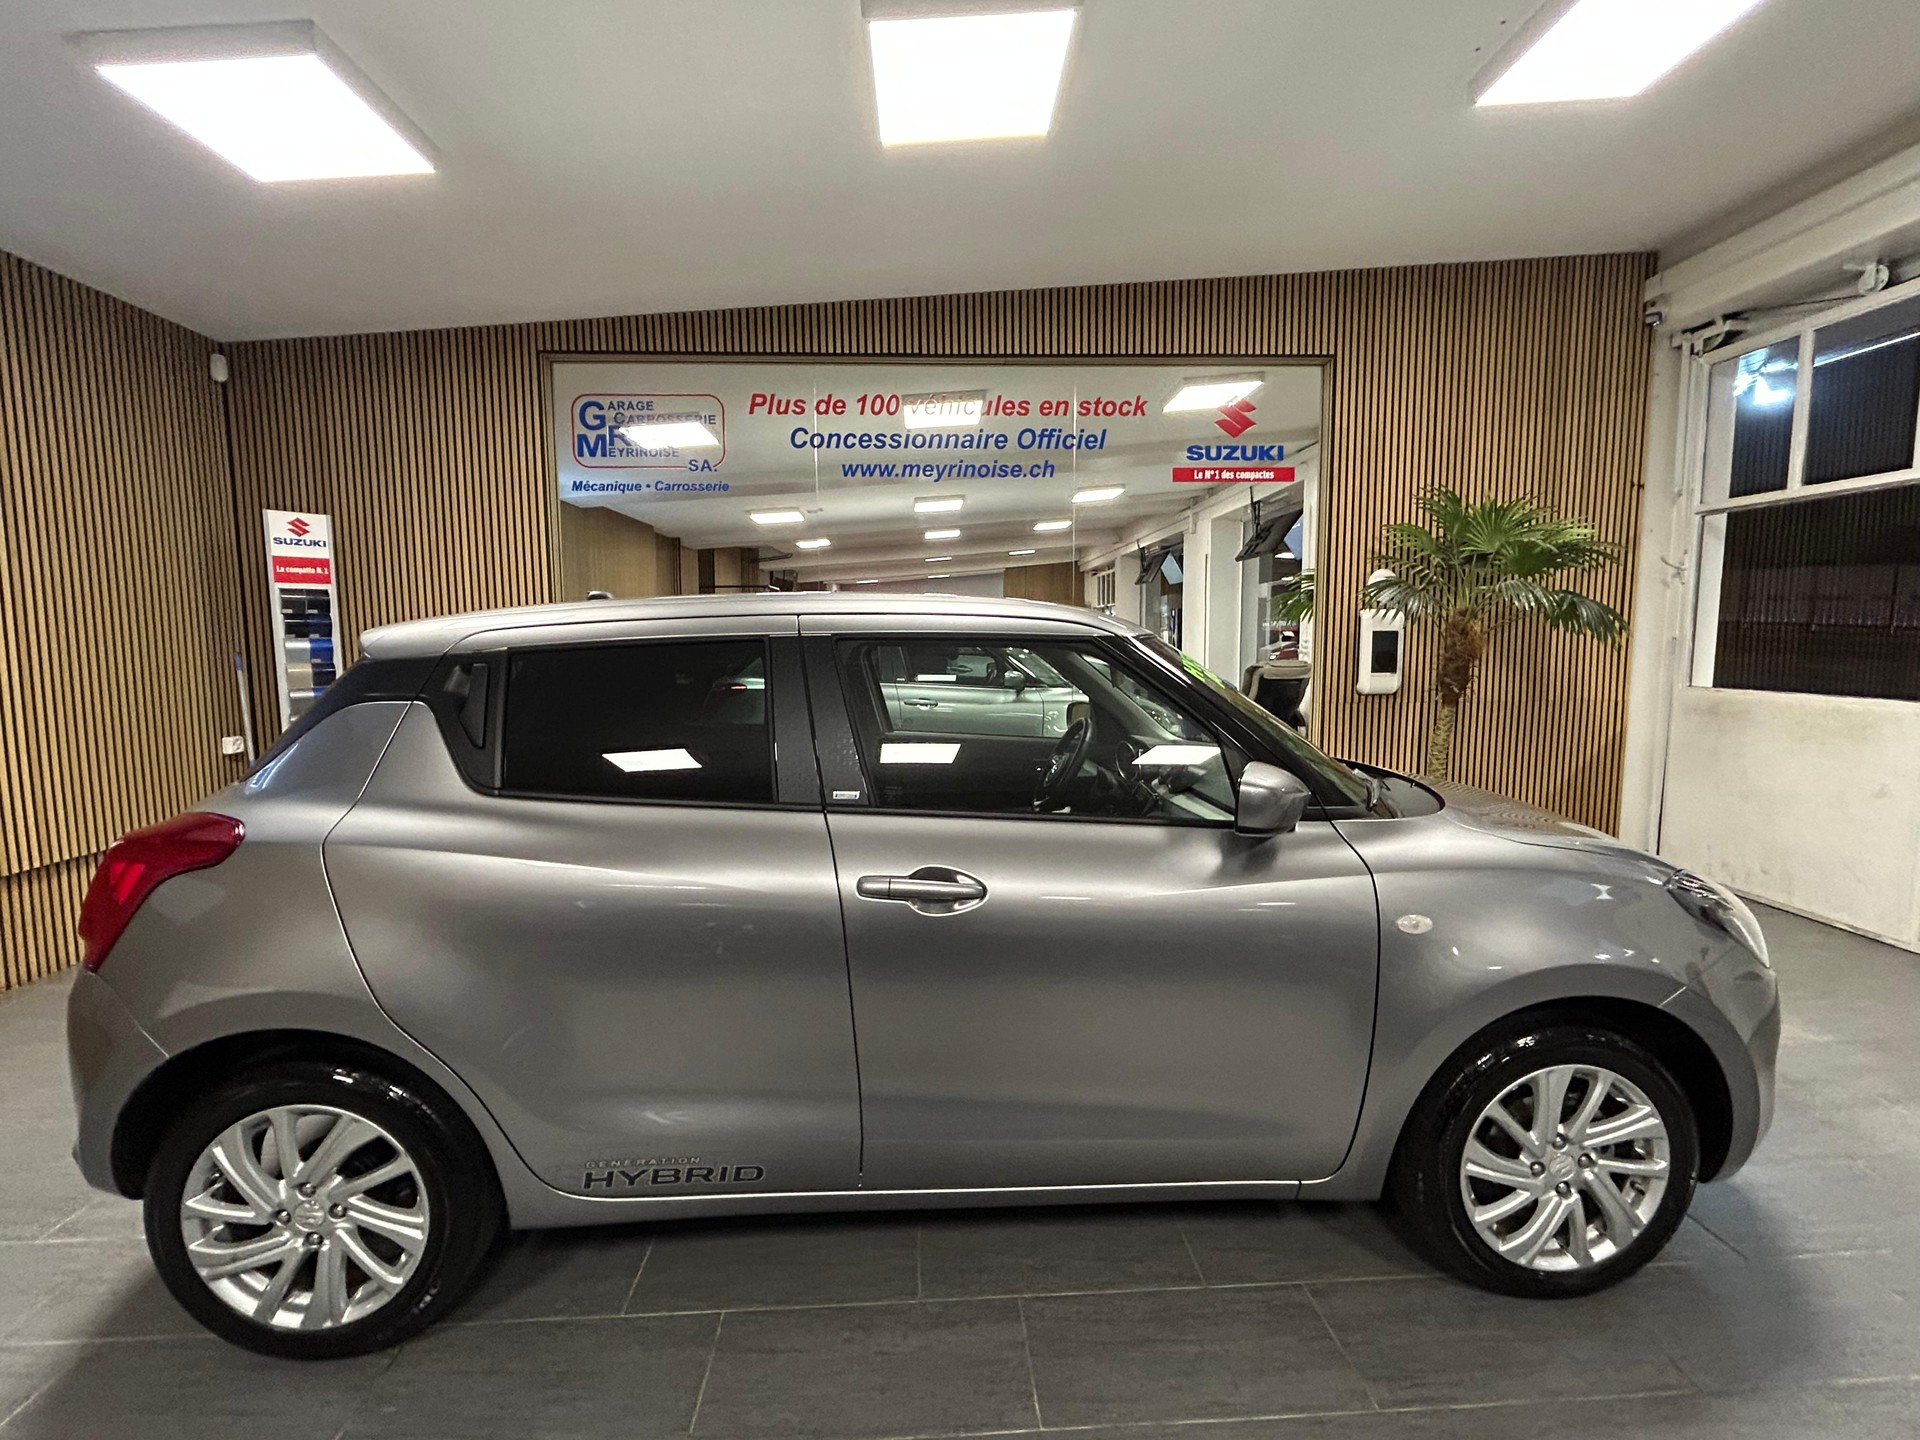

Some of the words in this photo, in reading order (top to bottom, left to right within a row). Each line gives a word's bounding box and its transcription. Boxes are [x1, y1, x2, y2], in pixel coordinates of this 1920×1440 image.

[748, 393, 806, 416] Plus
[815, 394, 846, 416] de
[856, 394, 899, 416] 100
[908, 393, 1030, 417] véhicules
[1039, 399, 1069, 417] en
[1077, 395, 1148, 417] stock
[579, 401, 654, 431] GARAGE
[613, 411, 716, 425] CARROSSERIE
[577, 433, 679, 458] MEYRINOISE
[790, 427, 1008, 450] Concessionnaire
[1017, 427, 1107, 450] Officiel
[1186, 445, 1284, 461] SUZUKI
[688, 459, 718, 472] SA.
[842, 460, 1055, 483] www.meyrinoise.ch
[1193, 469, 1203, 479] Le
[1221, 470, 1234, 479] des
[1235, 470, 1275, 481] compactes
[571, 480, 643, 494] Mécanique
[654, 480, 730, 492] Carrosserie
[273, 537, 327, 547] SUZUKI
[586, 1157, 701, 1168] GENERATION
[583, 1166, 765, 1189] HYBRID
